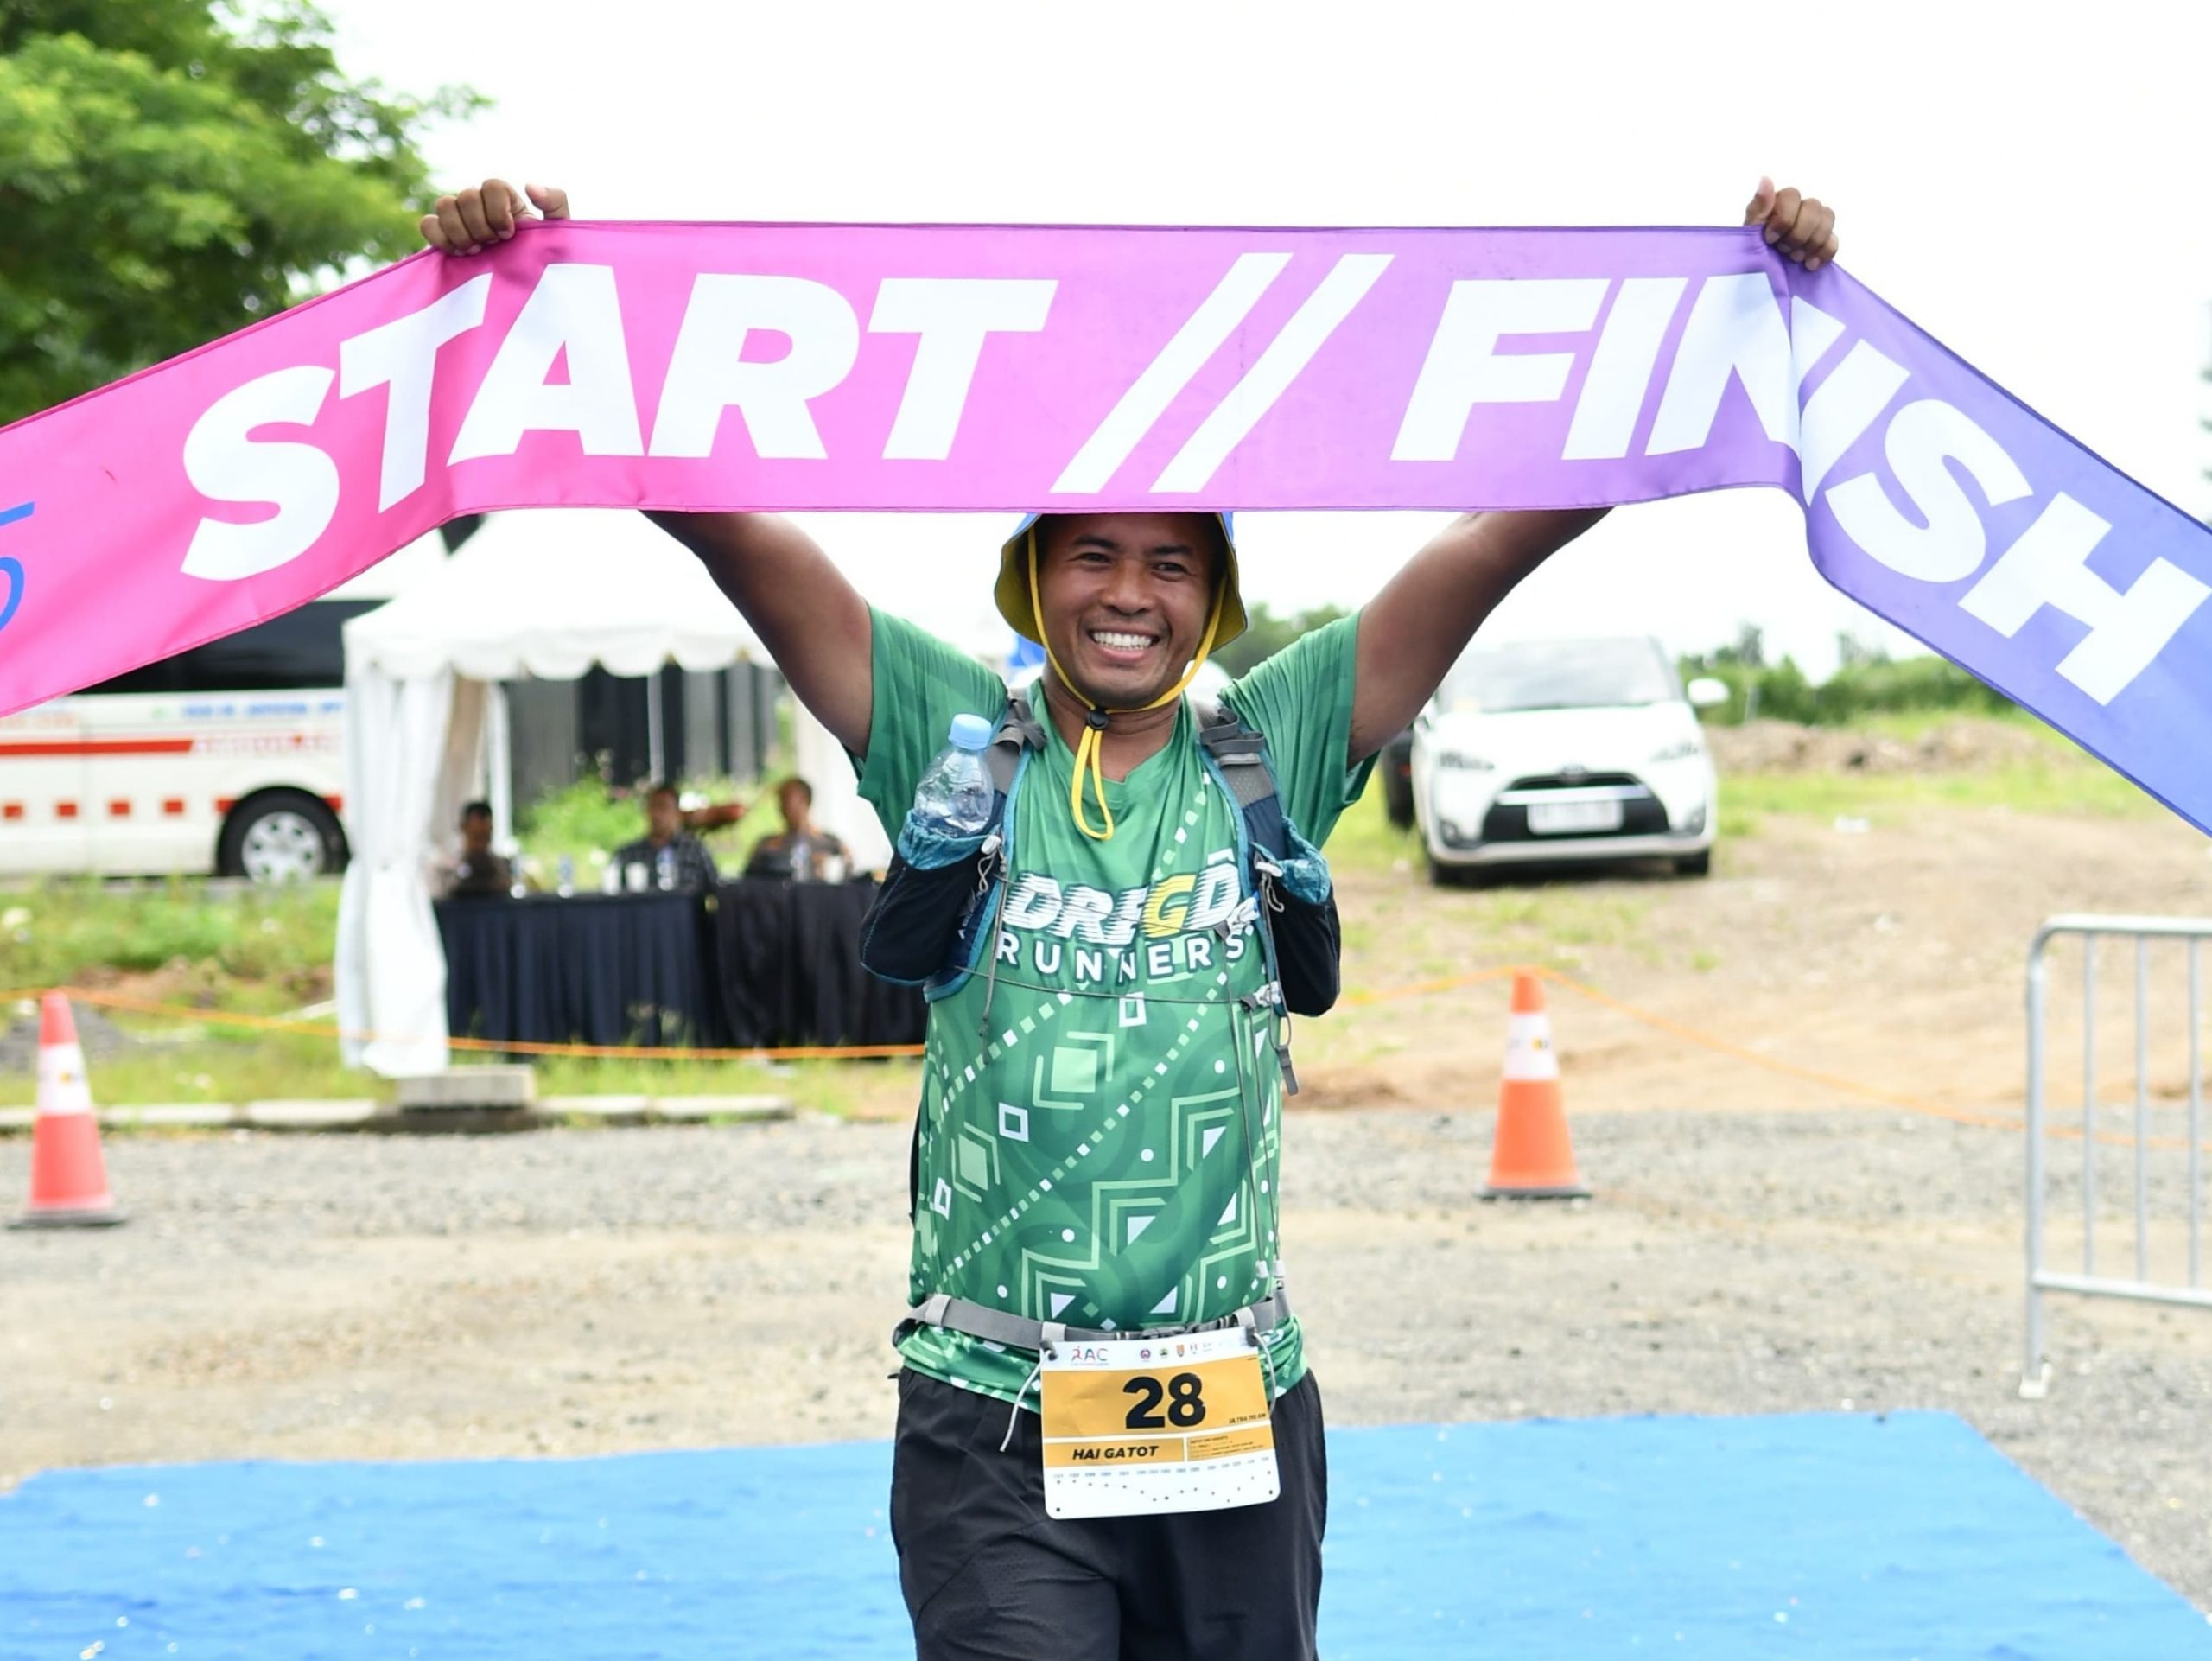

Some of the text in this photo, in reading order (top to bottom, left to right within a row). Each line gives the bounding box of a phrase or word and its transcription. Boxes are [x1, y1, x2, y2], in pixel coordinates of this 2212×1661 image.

[180, 263, 1059, 582] START
[1389, 271, 2211, 707] FINISH
[996, 932, 1245, 983] RUNNERS
[1122, 1372, 1206, 1429] 28
[1072, 1446, 1160, 1461] HAI GATOT
